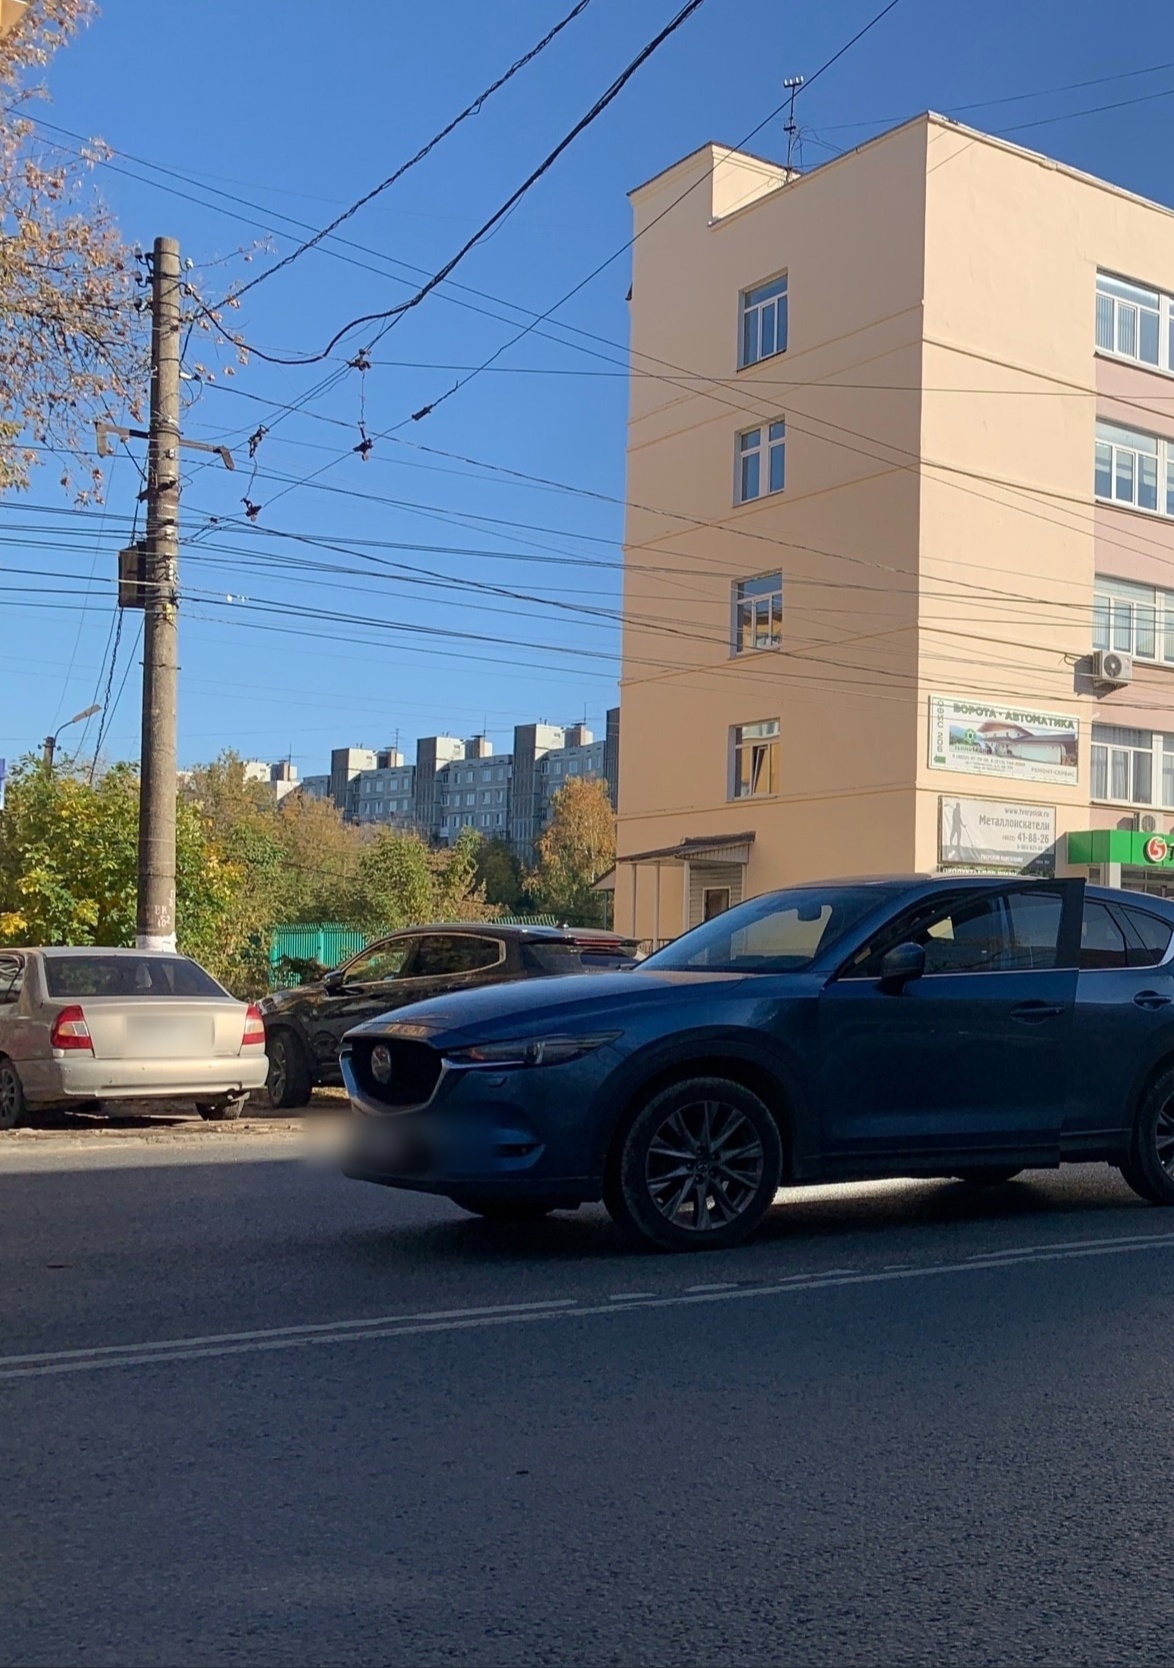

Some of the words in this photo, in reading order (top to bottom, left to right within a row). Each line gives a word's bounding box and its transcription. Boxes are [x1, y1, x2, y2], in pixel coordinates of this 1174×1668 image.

[953, 702, 997, 719] ВОРОТА
[1005, 711, 1075, 730] АВТОМАТИКА
[1031, 767, 1076, 777] РЕМОНТ-СЕРВИС
[979, 815, 1050, 831] Металлоискатели
